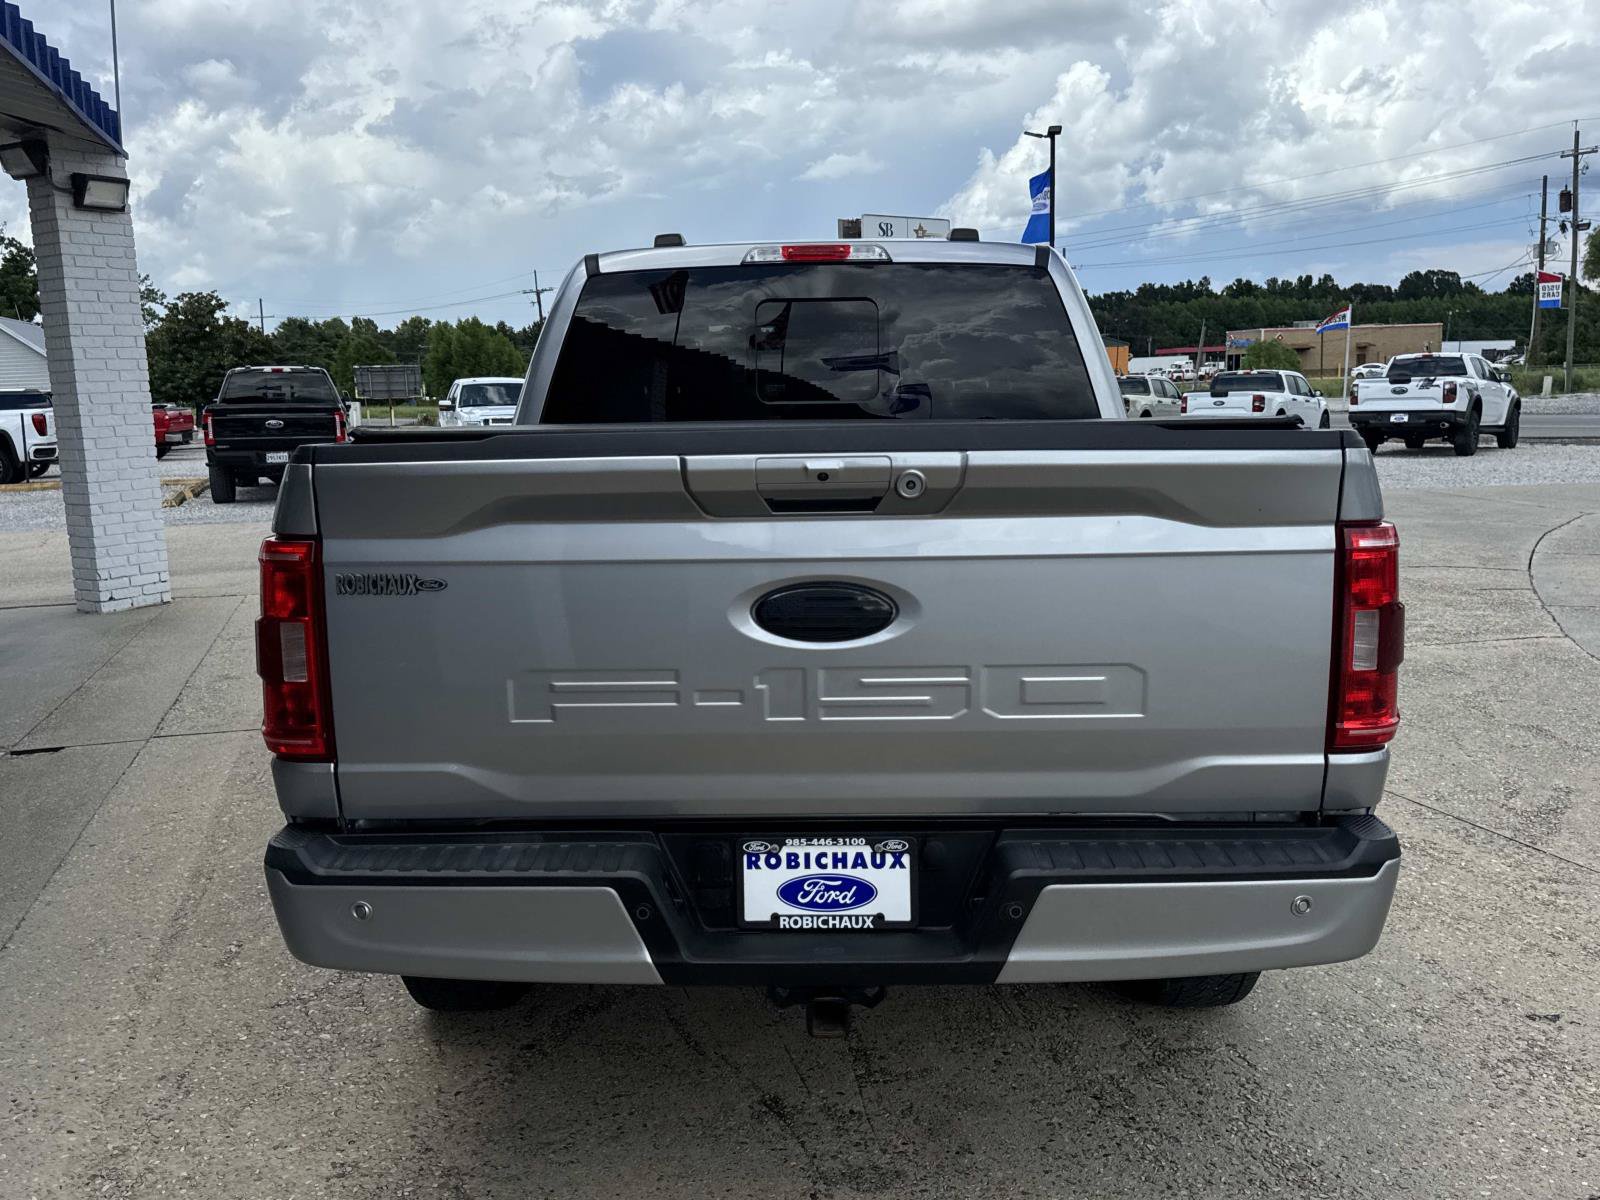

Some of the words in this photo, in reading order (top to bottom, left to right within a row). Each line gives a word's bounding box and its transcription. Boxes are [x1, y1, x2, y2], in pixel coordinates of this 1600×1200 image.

[878, 222, 894, 237] SB
[335, 574, 419, 595] ROBICHAUX
[507, 663, 1147, 724] F-150
[785, 838, 866, 846] 985-446-3100
[746, 852, 906, 870] ROBICHAUX
[797, 879, 857, 904] Ford
[780, 916, 874, 929] ROBICHAUX
